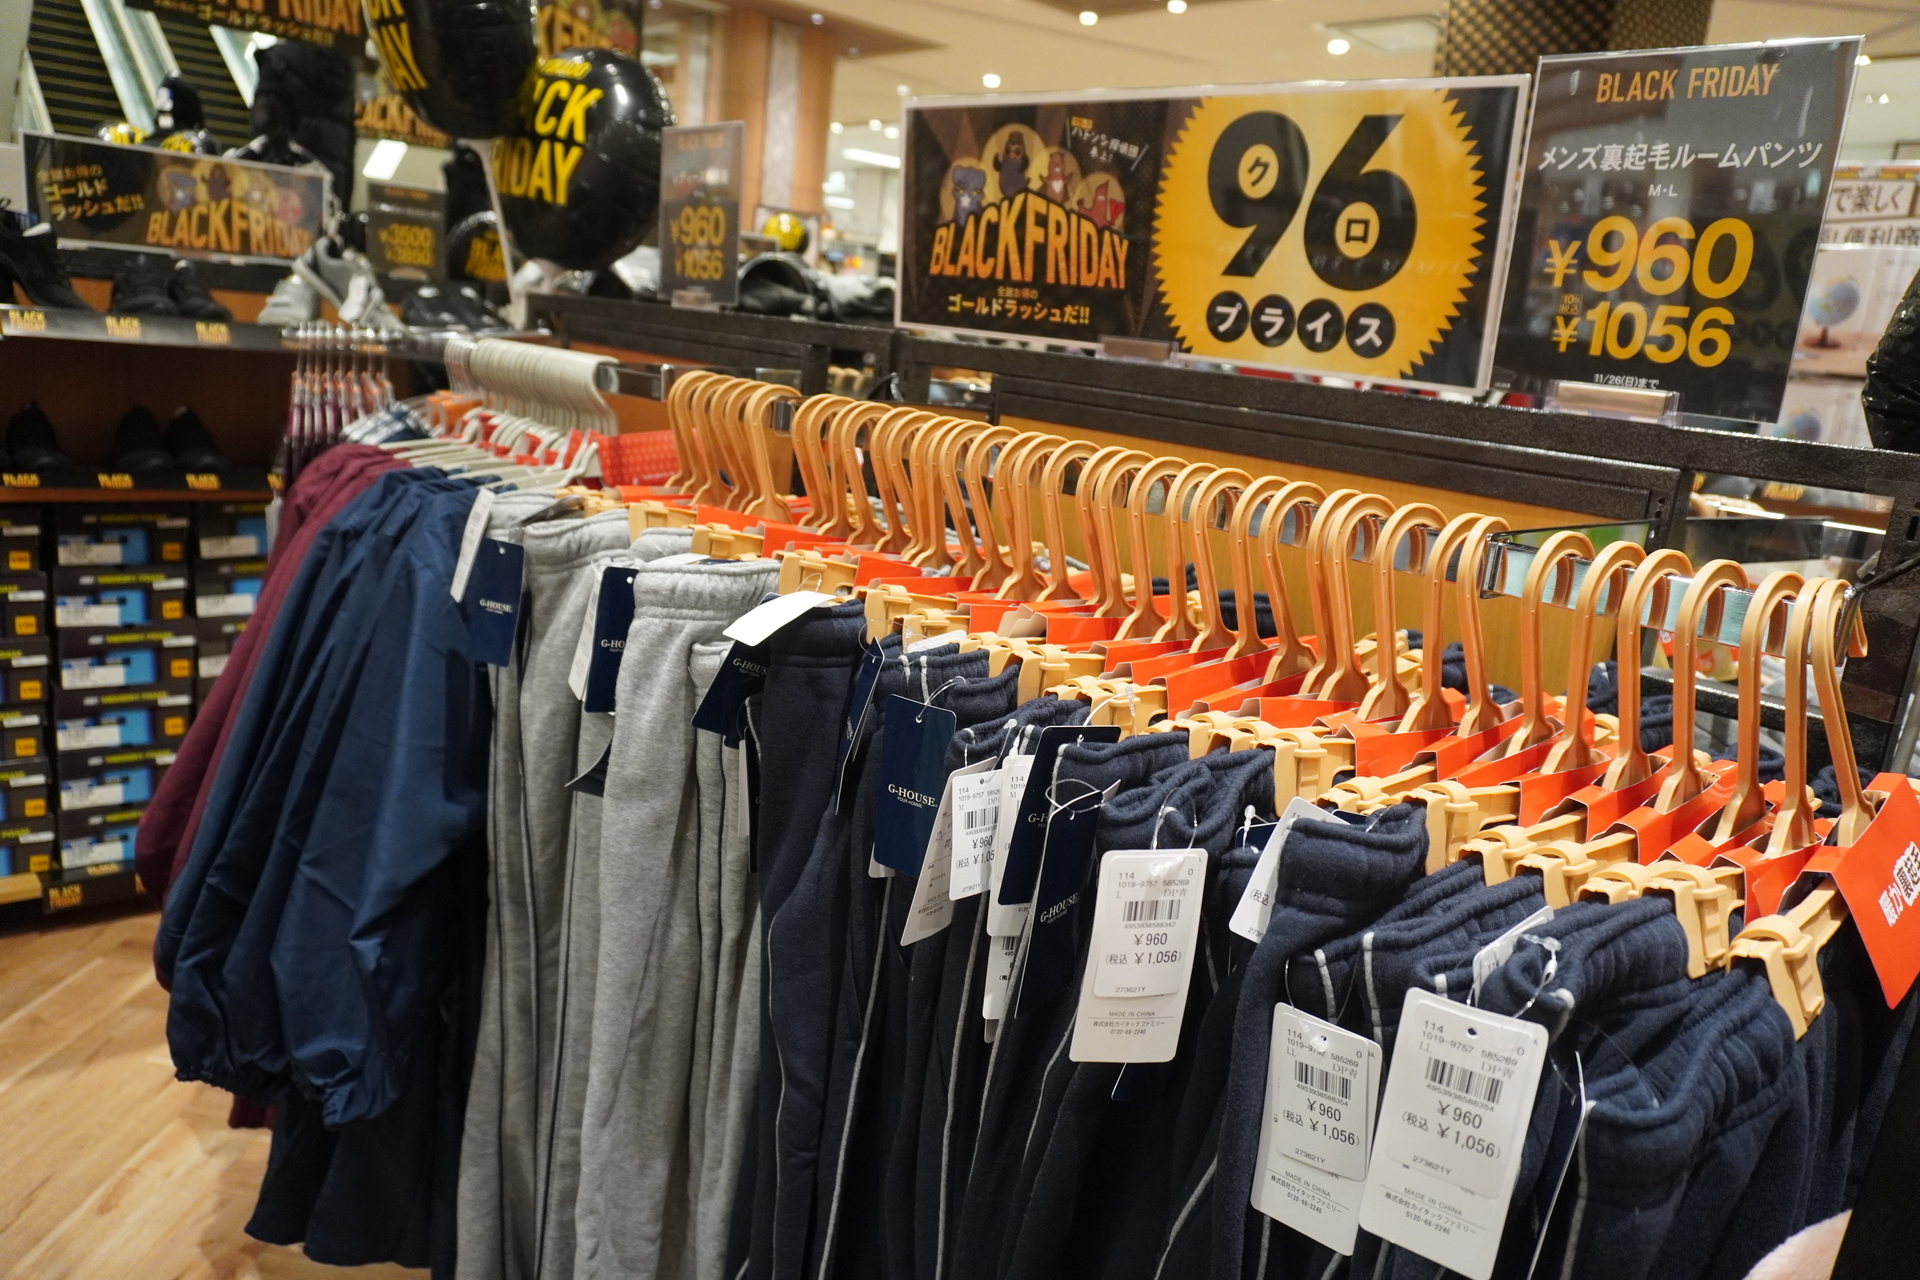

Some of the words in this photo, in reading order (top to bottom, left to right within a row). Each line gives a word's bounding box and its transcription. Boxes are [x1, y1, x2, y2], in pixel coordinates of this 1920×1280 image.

[1596, 69, 1679, 104] BLACK
[1687, 62, 1780, 98] FRIDAY
[1538, 142, 1824, 173] メンズ裏起毛ルームパンツ
[1208, 110, 1418, 292] 96
[670, 206, 726, 246] ¥960
[1544, 215, 1754, 299] ¥960
[1214, 301, 1384, 349] プライス
[1552, 301, 1735, 368] ¥1056
[888, 783, 936, 807] G-HOUSE
[1119, 872, 1135, 880] 114
[1040, 892, 1079, 922] G-HOUSE
[1287, 1028, 1302, 1039] 114
[1425, 1020, 1444, 1033] 114
[1330, 1053, 1359, 1068] 585269
[1423, 1031, 1474, 1053] 1019-9757
[1481, 1050, 1518, 1067] 585269
[1295, 1148, 1326, 1164] 273621Y
[1412, 1155, 1452, 1175] 273621Y
[1285, 1171, 1302, 1184] MADE
[1312, 1184, 1331, 1198] CHINA
[1404, 1187, 1425, 1201] MADE
[1428, 1197, 1437, 1205] IN
[1438, 1202, 1463, 1217] CHINA
